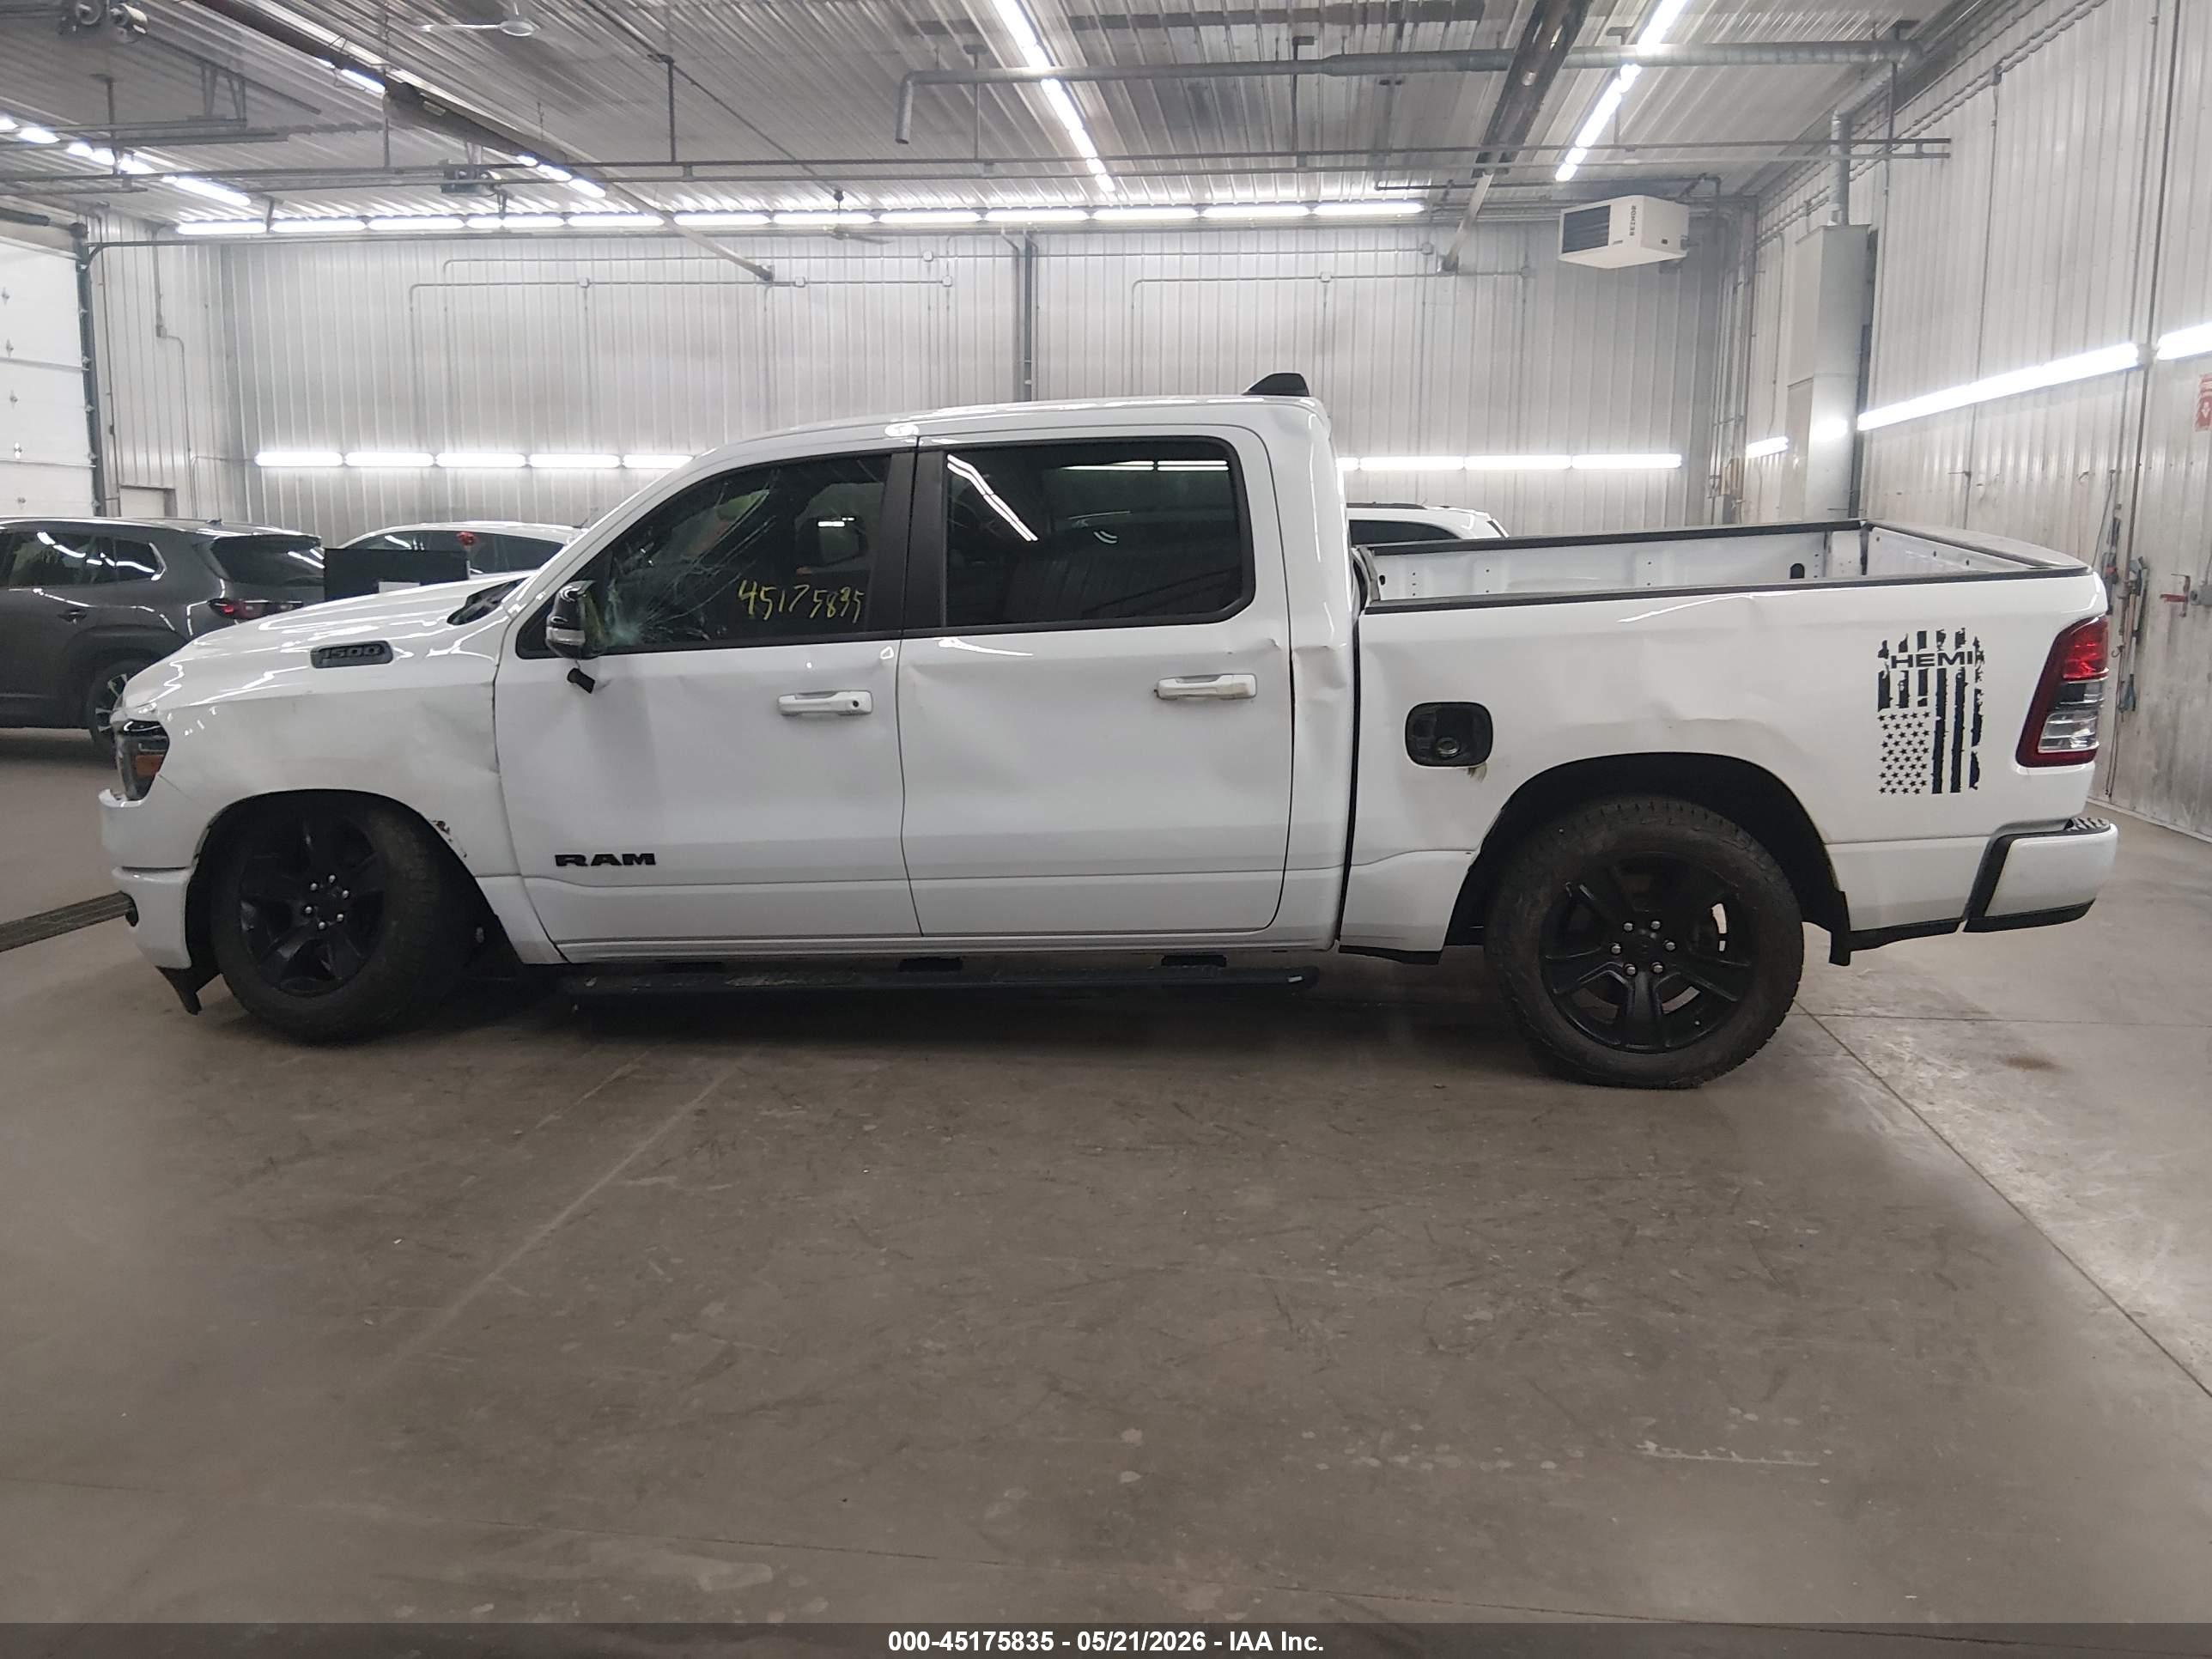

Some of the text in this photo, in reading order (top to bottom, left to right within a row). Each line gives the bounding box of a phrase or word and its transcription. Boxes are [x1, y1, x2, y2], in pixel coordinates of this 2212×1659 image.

[318, 644, 384, 660] 1500
[1891, 651, 1973, 669] HEMI
[555, 853, 656, 866] RAM
